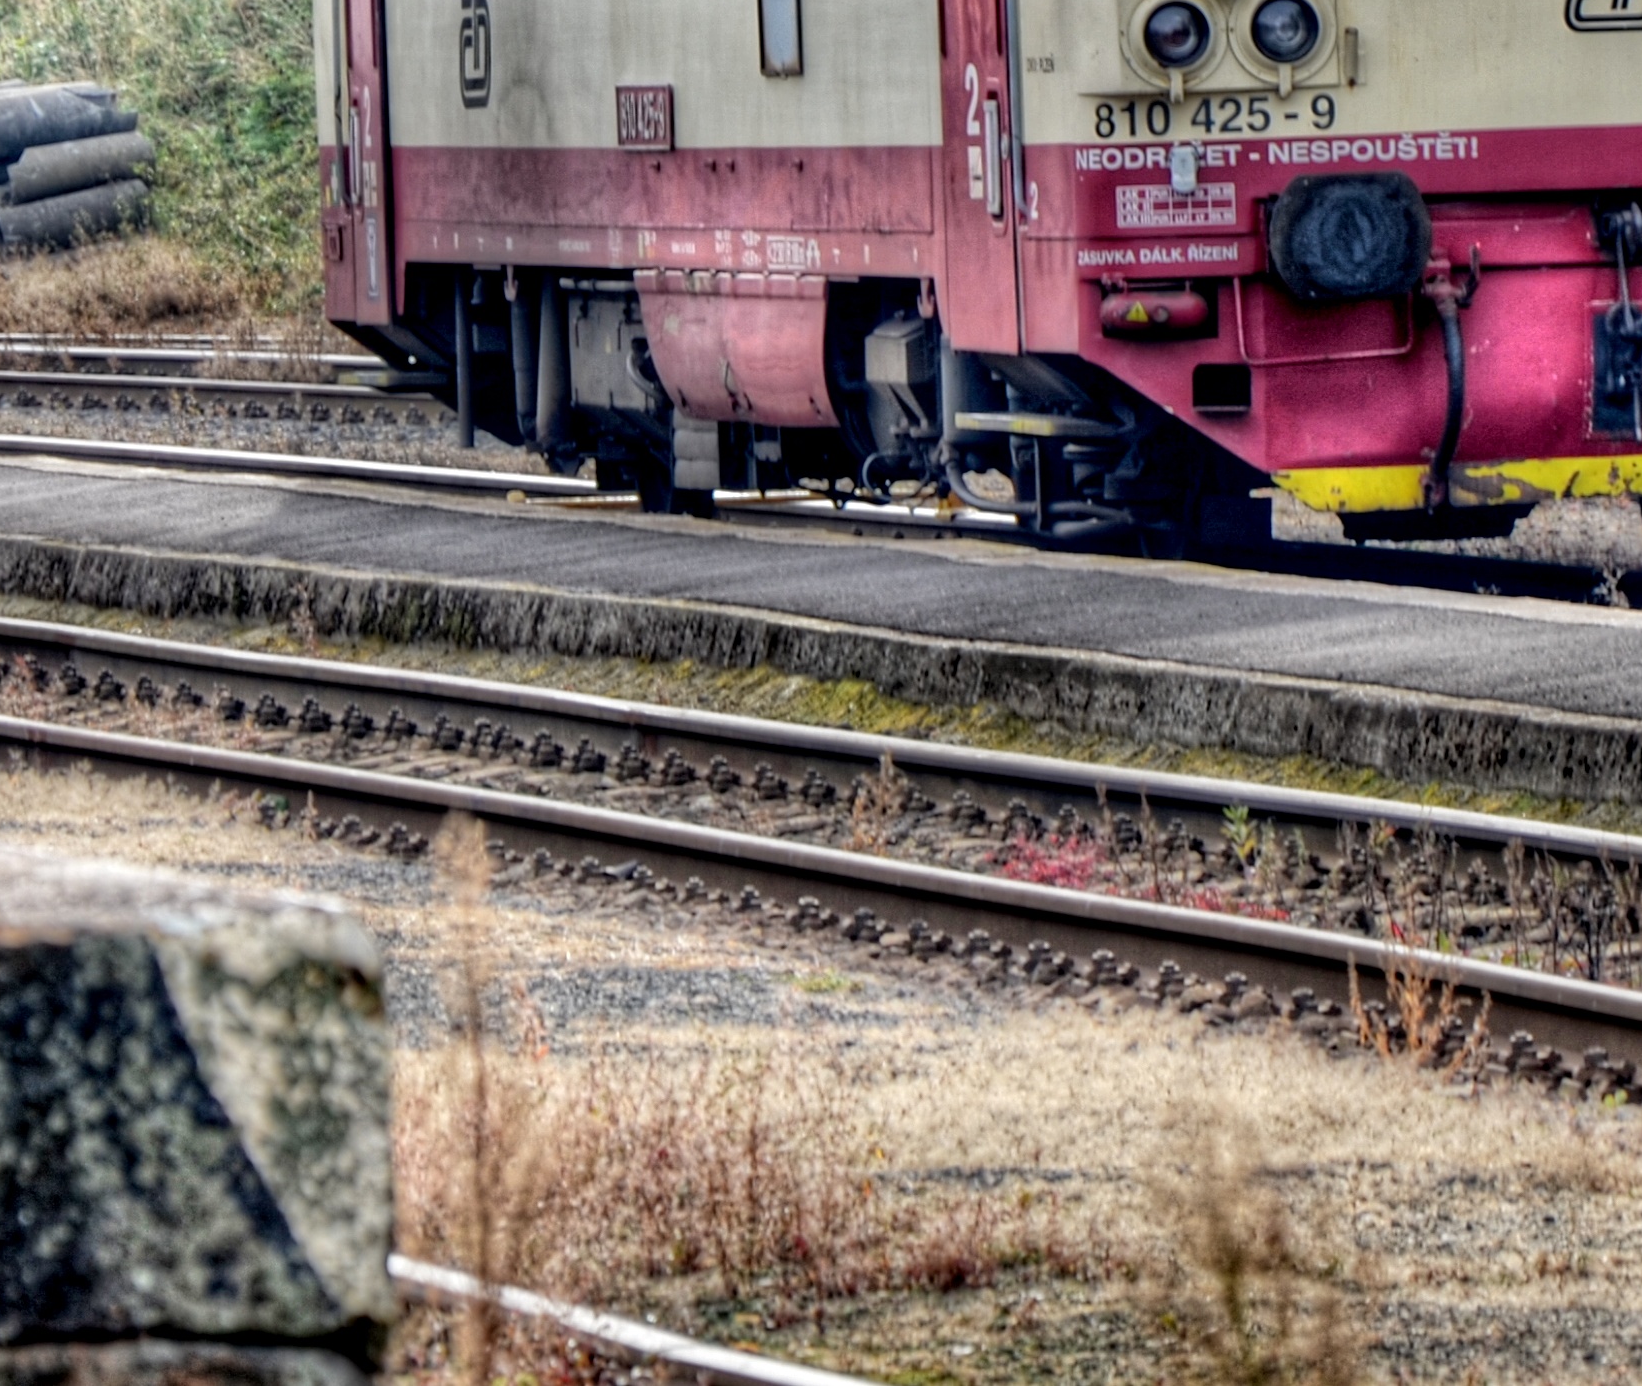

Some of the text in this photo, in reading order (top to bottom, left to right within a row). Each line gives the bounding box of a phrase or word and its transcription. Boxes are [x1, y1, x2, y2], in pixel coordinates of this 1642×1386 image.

[363, 85, 373, 148] 2
[965, 63, 981, 136] 2
[1095, 99, 1171, 138] 810
[1076, 139, 1242, 170] NEODRET
[1268, 130, 1479, 165] NESPOUŠTĚT!
[1030, 181, 1039, 219] 2
[1078, 248, 1136, 265] ZÁSUVKA
[1187, 241, 1239, 262] ŘÍZENÍ
